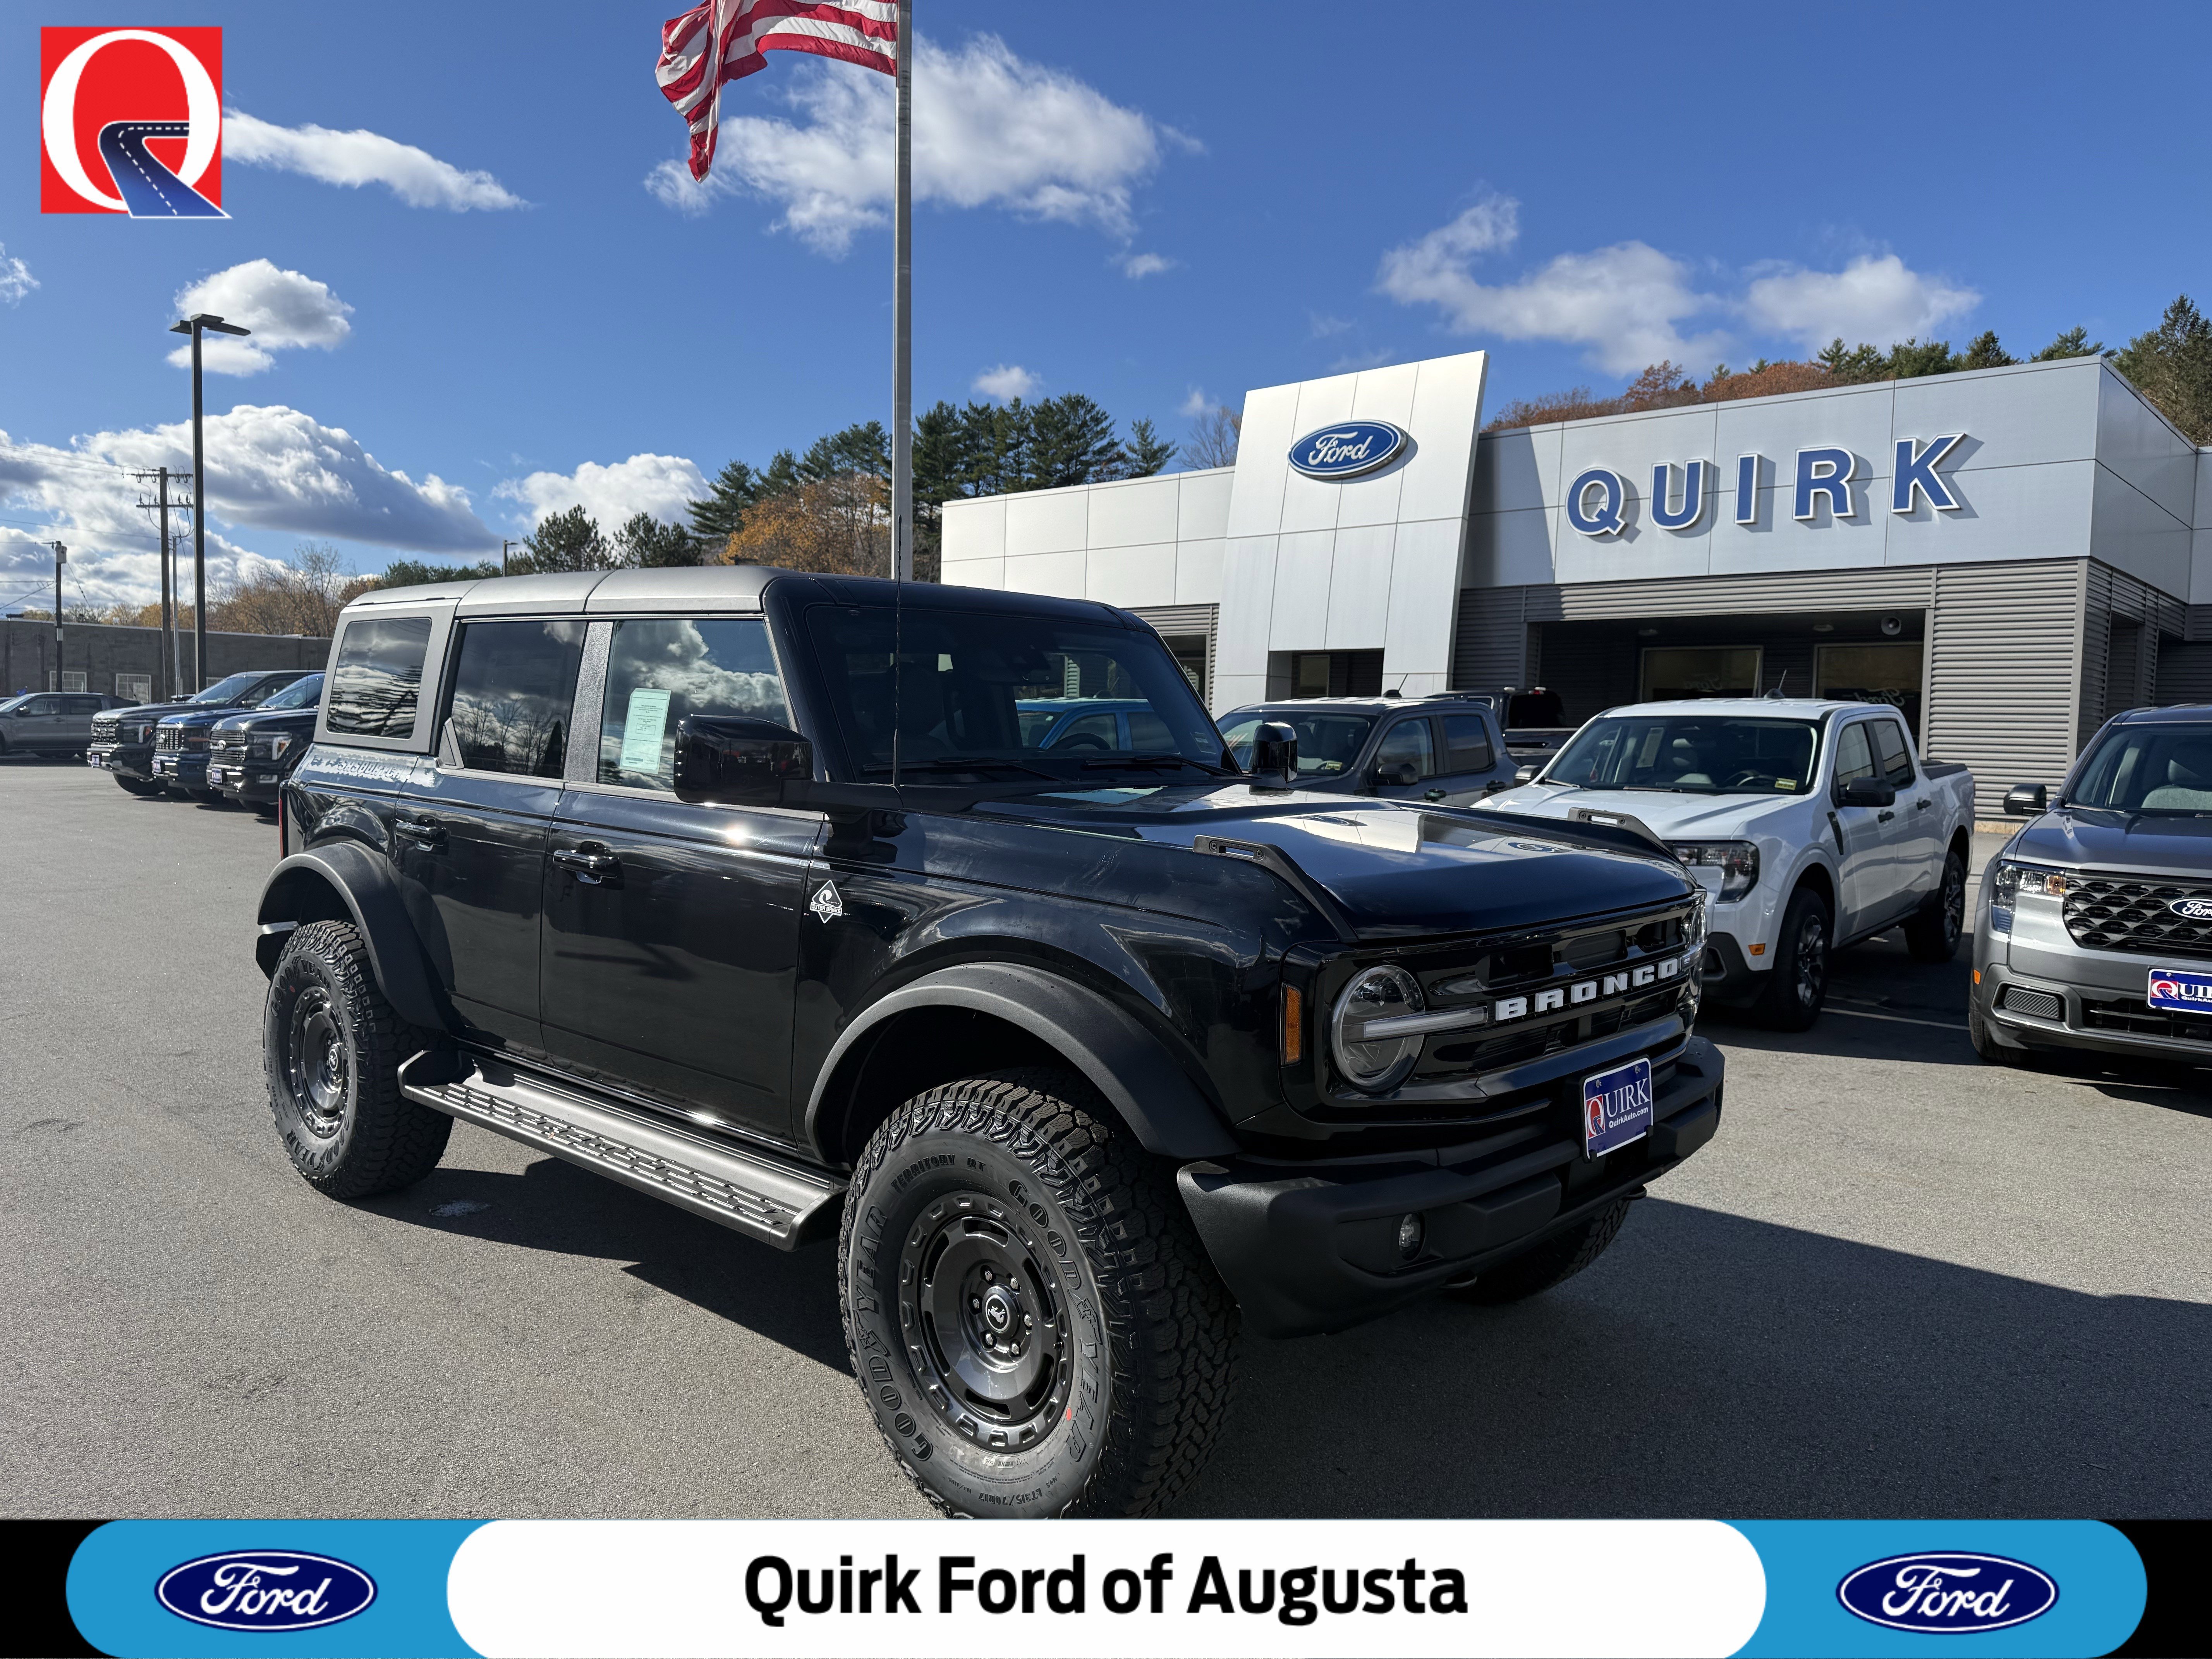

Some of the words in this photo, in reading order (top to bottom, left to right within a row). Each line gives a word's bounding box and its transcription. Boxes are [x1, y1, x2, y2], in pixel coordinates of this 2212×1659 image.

[1308, 431, 1374, 465] Ford
[1565, 432, 1965, 535] QUIRK
[826, 905, 841, 914] BANKS
[2182, 901, 2212, 916] For
[1495, 958, 1678, 1021] BRONCO
[1587, 1078, 1650, 1135] QUIRK
[1609, 1107, 1649, 1128] QuirkAuto.com
[891, 1154, 955, 1194] TERRITORY
[967, 1157, 986, 1172] RT
[978, 1487, 1043, 1506] LT315/70R17
